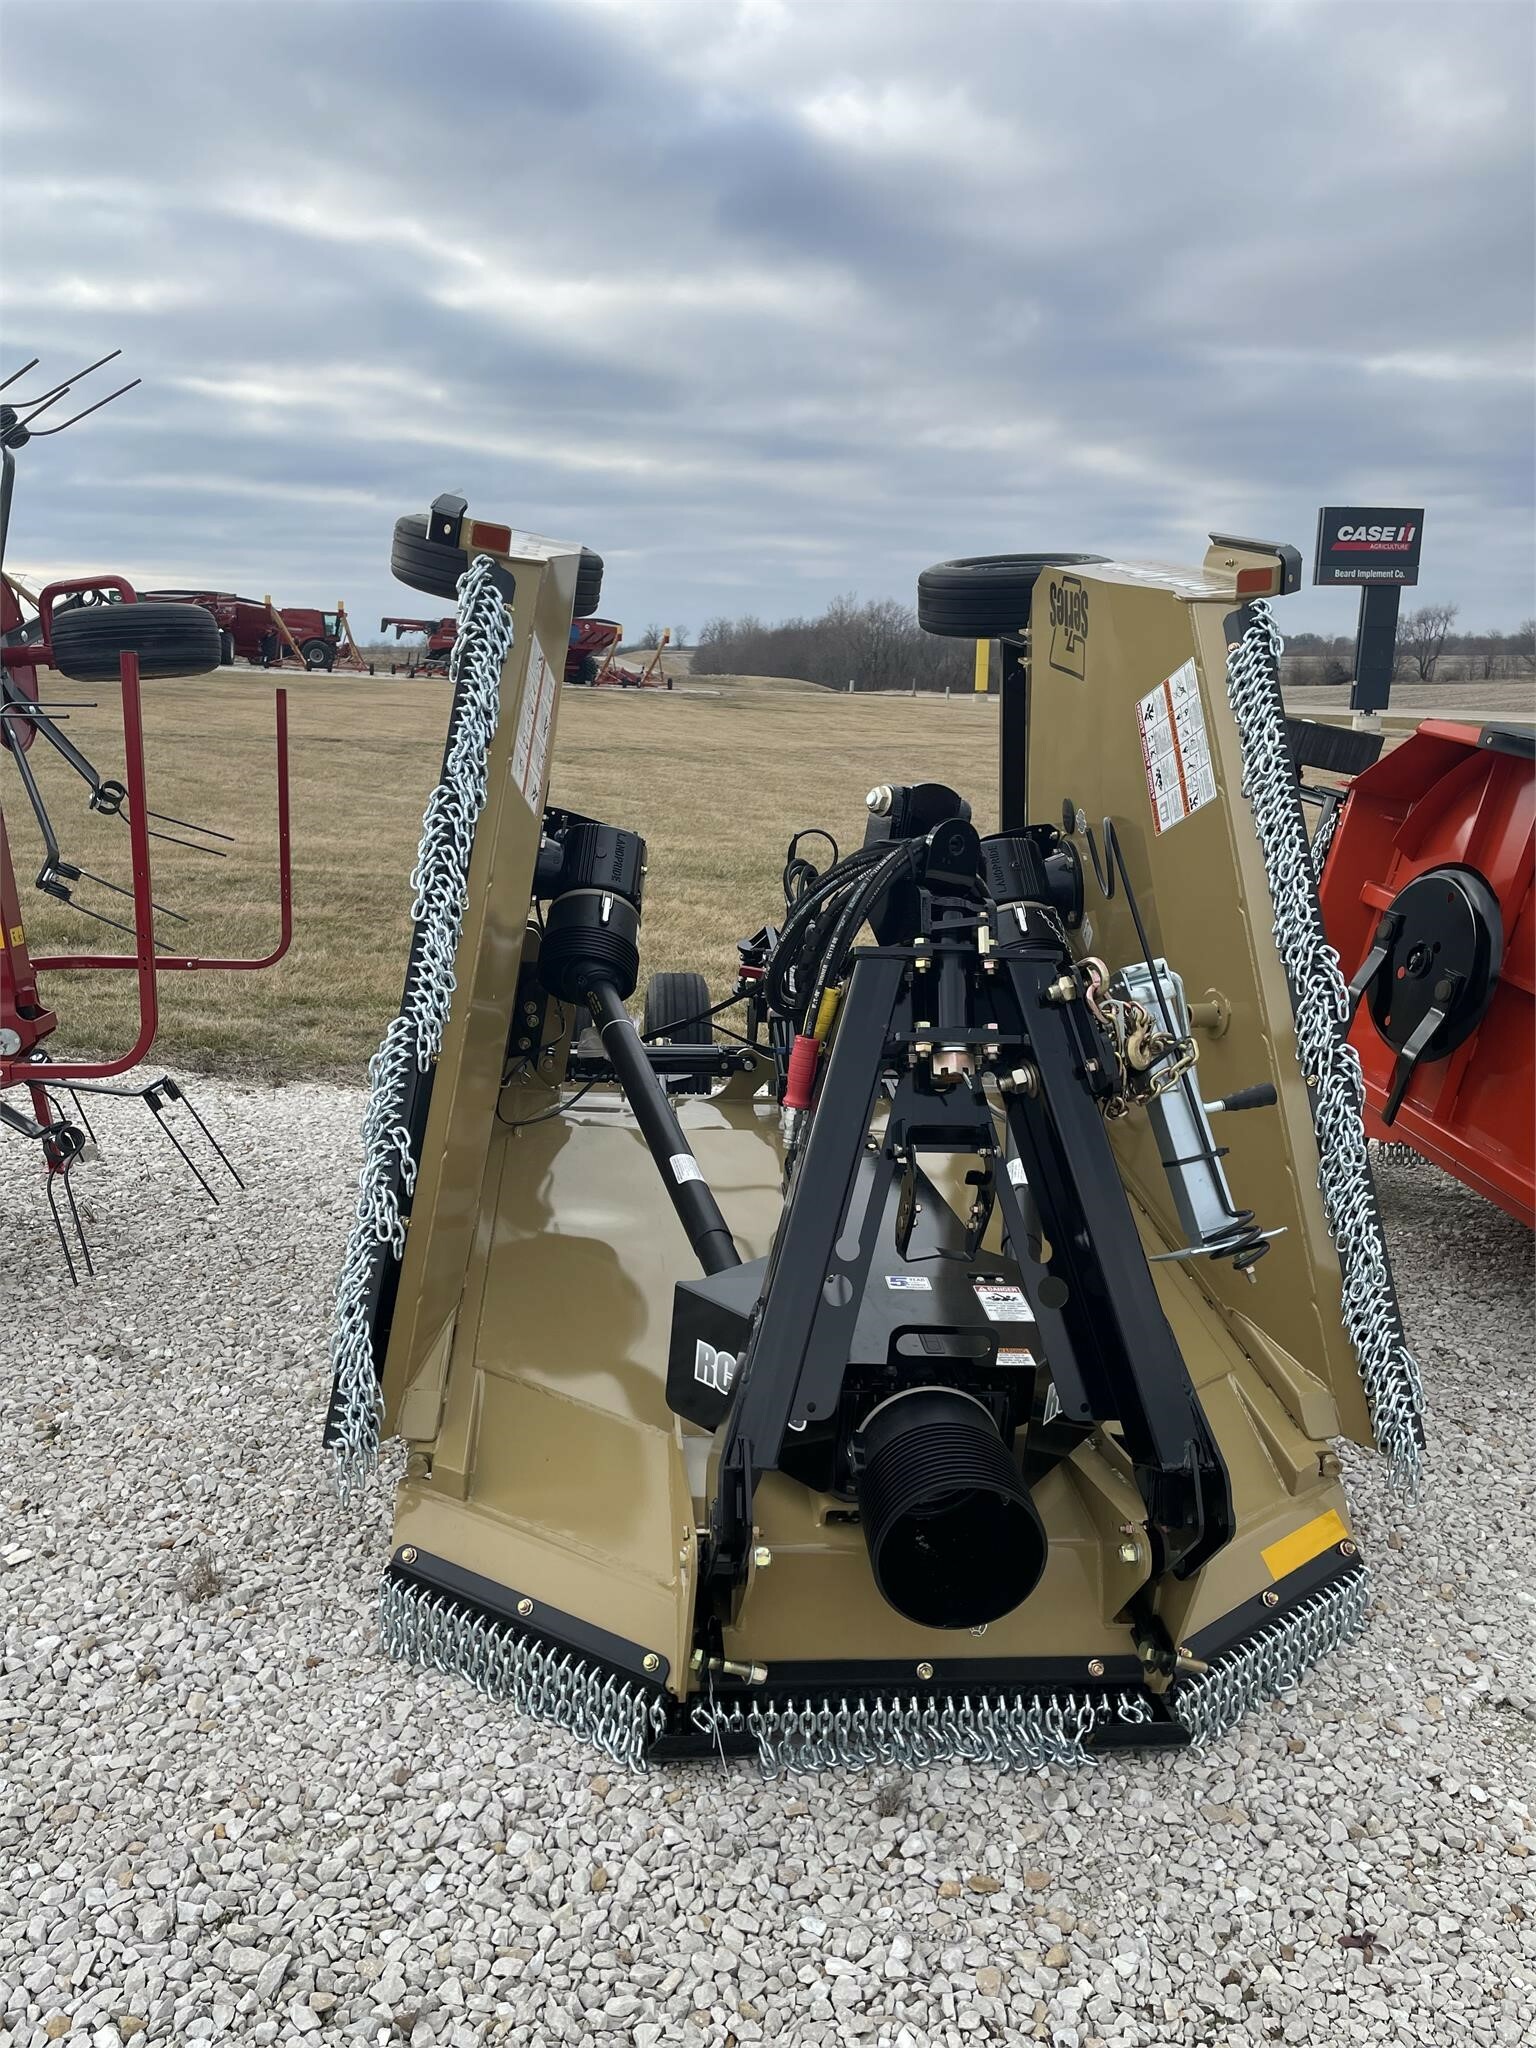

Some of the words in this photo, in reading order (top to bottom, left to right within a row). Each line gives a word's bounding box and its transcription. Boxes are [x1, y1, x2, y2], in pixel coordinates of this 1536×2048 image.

[1337, 526, 1397, 542] CASE
[1369, 543, 1409, 551] AGRICULTURE
[1335, 569, 1357, 578] Beard
[1357, 569, 1394, 579] Implement
[1394, 569, 1406, 578] Co.
[1050, 582, 1089, 640] Series
